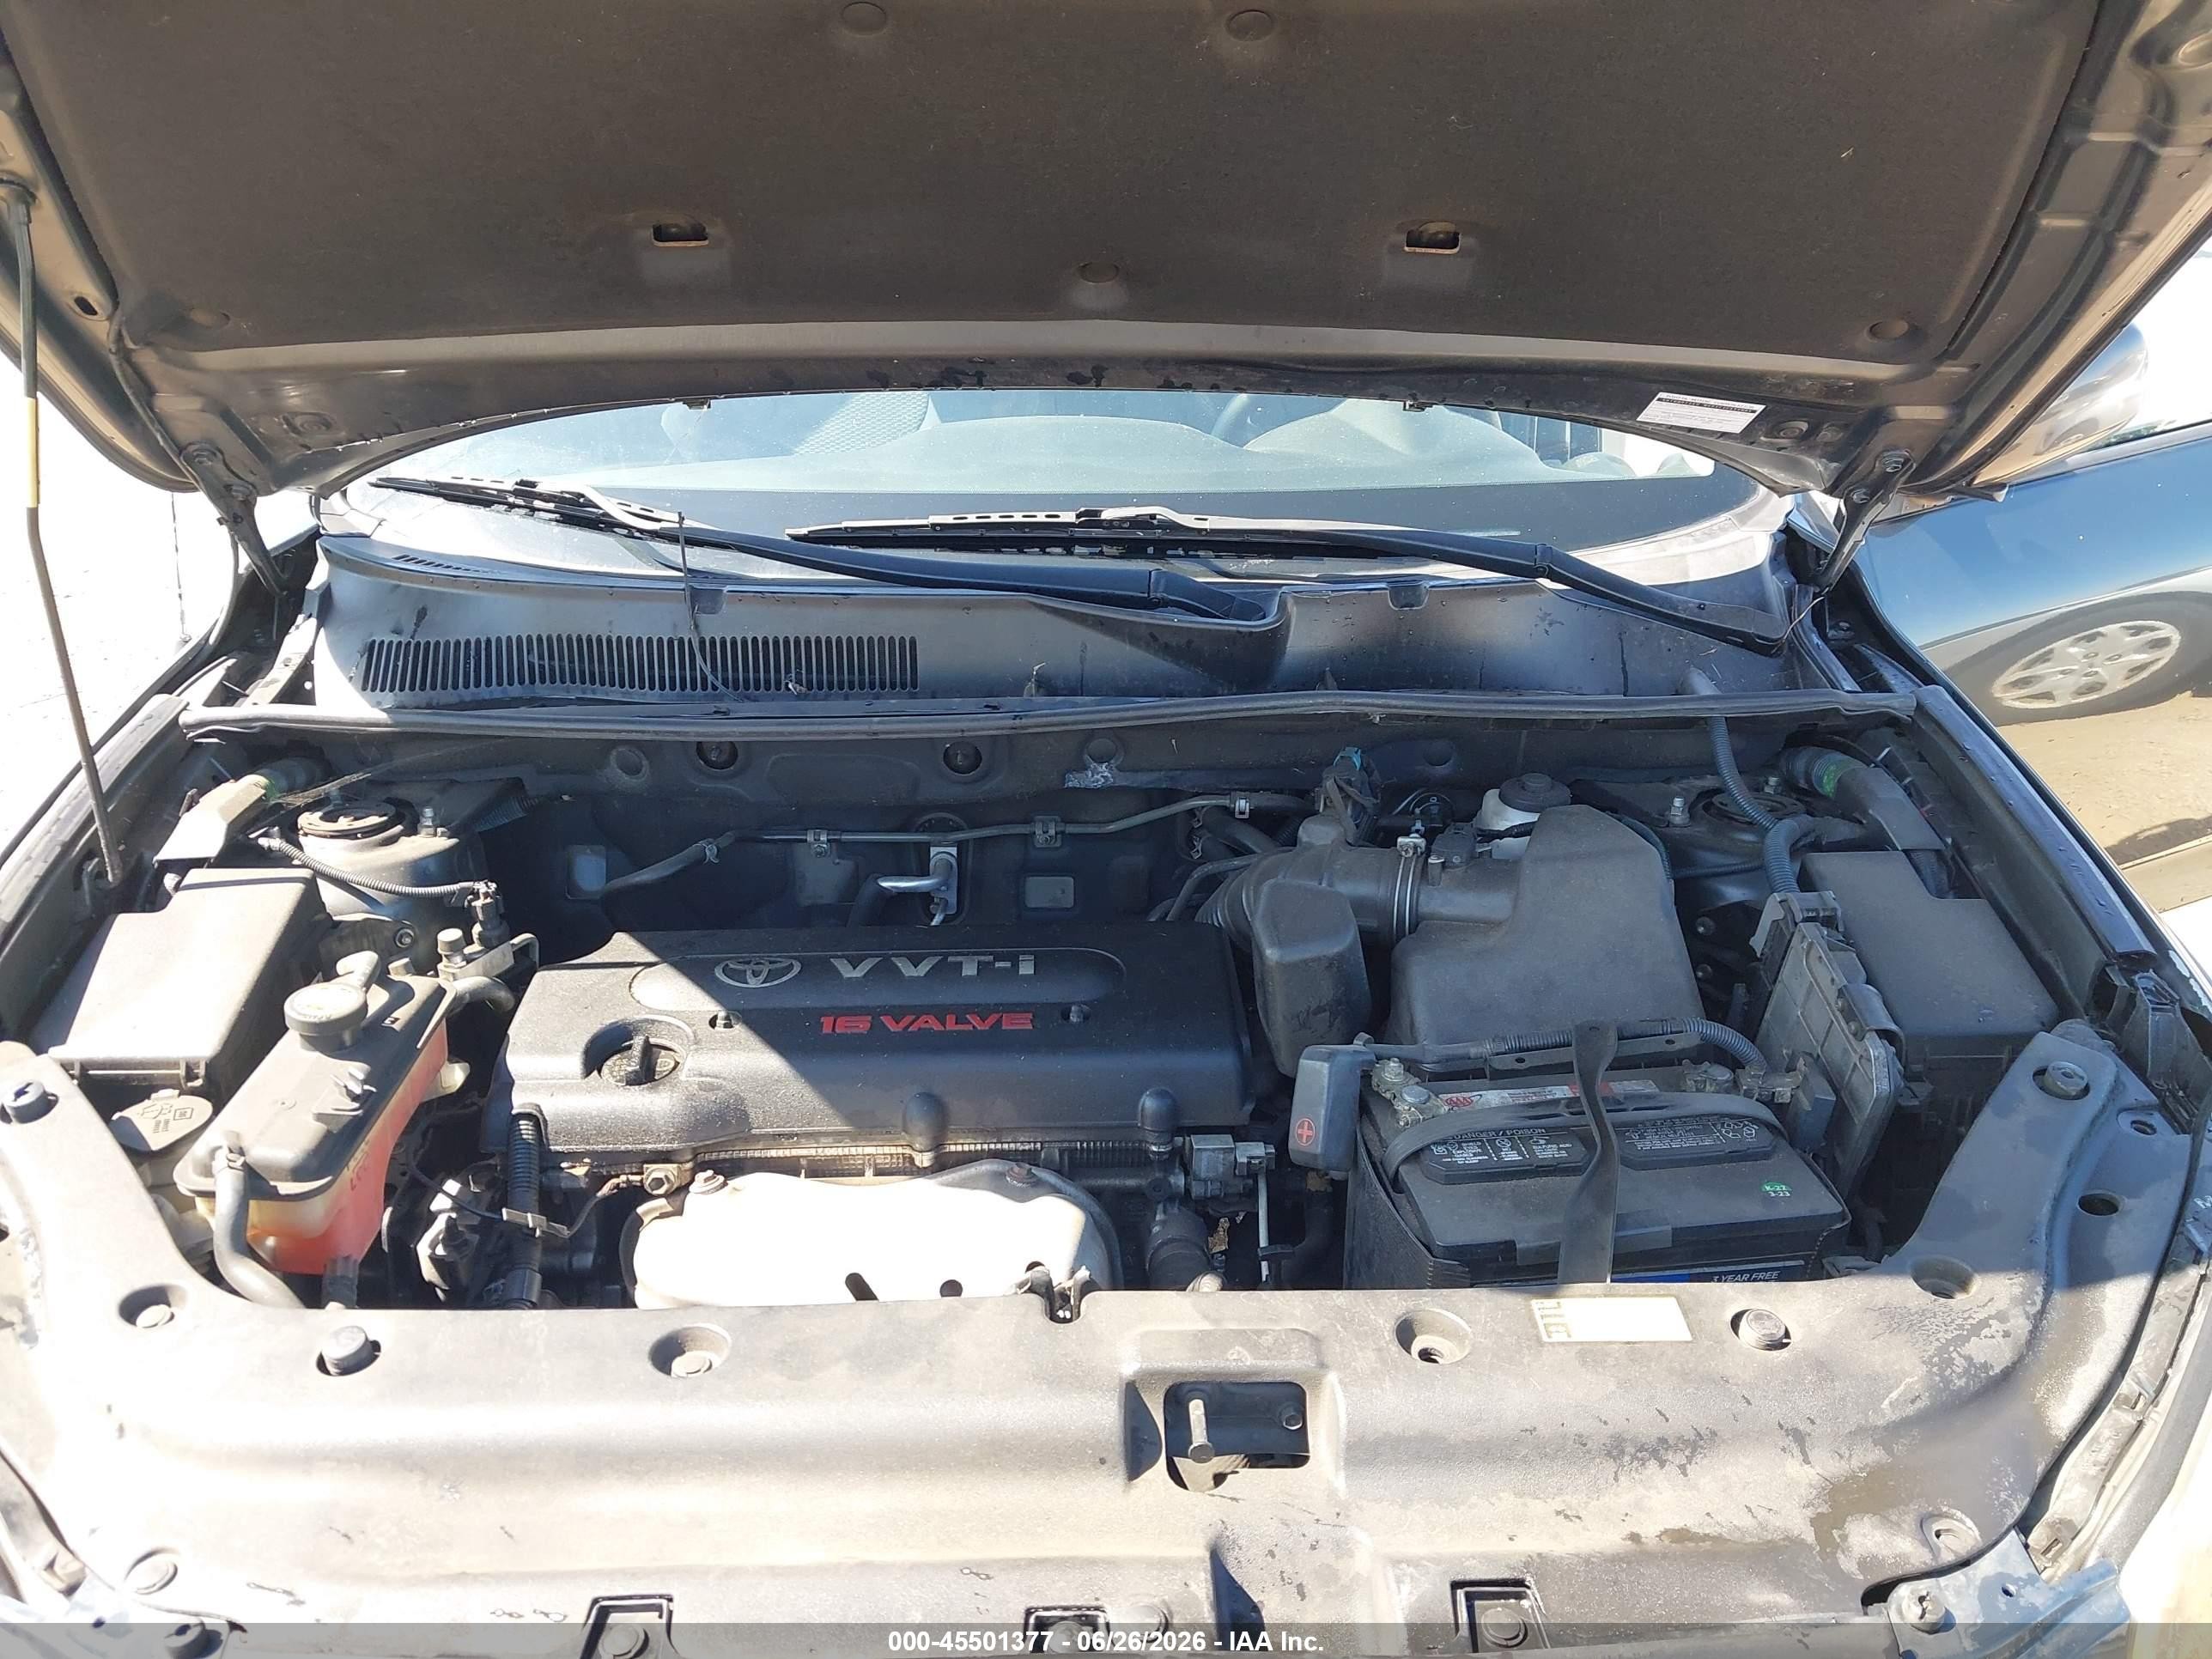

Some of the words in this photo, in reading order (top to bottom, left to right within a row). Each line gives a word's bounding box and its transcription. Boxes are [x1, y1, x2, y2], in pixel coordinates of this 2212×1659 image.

[830, 954, 1035, 978] VVT-i
[820, 1015, 872, 1034] 16
[879, 1012, 1034, 1032] VALVE
[1444, 1097, 1474, 1107] AAA
[1454, 1130, 1497, 1139] DANGER
[1508, 1127, 1547, 1136] POISON
[1721, 1273, 1750, 1282] YEAR
[1750, 1271, 1781, 1281] FREE
